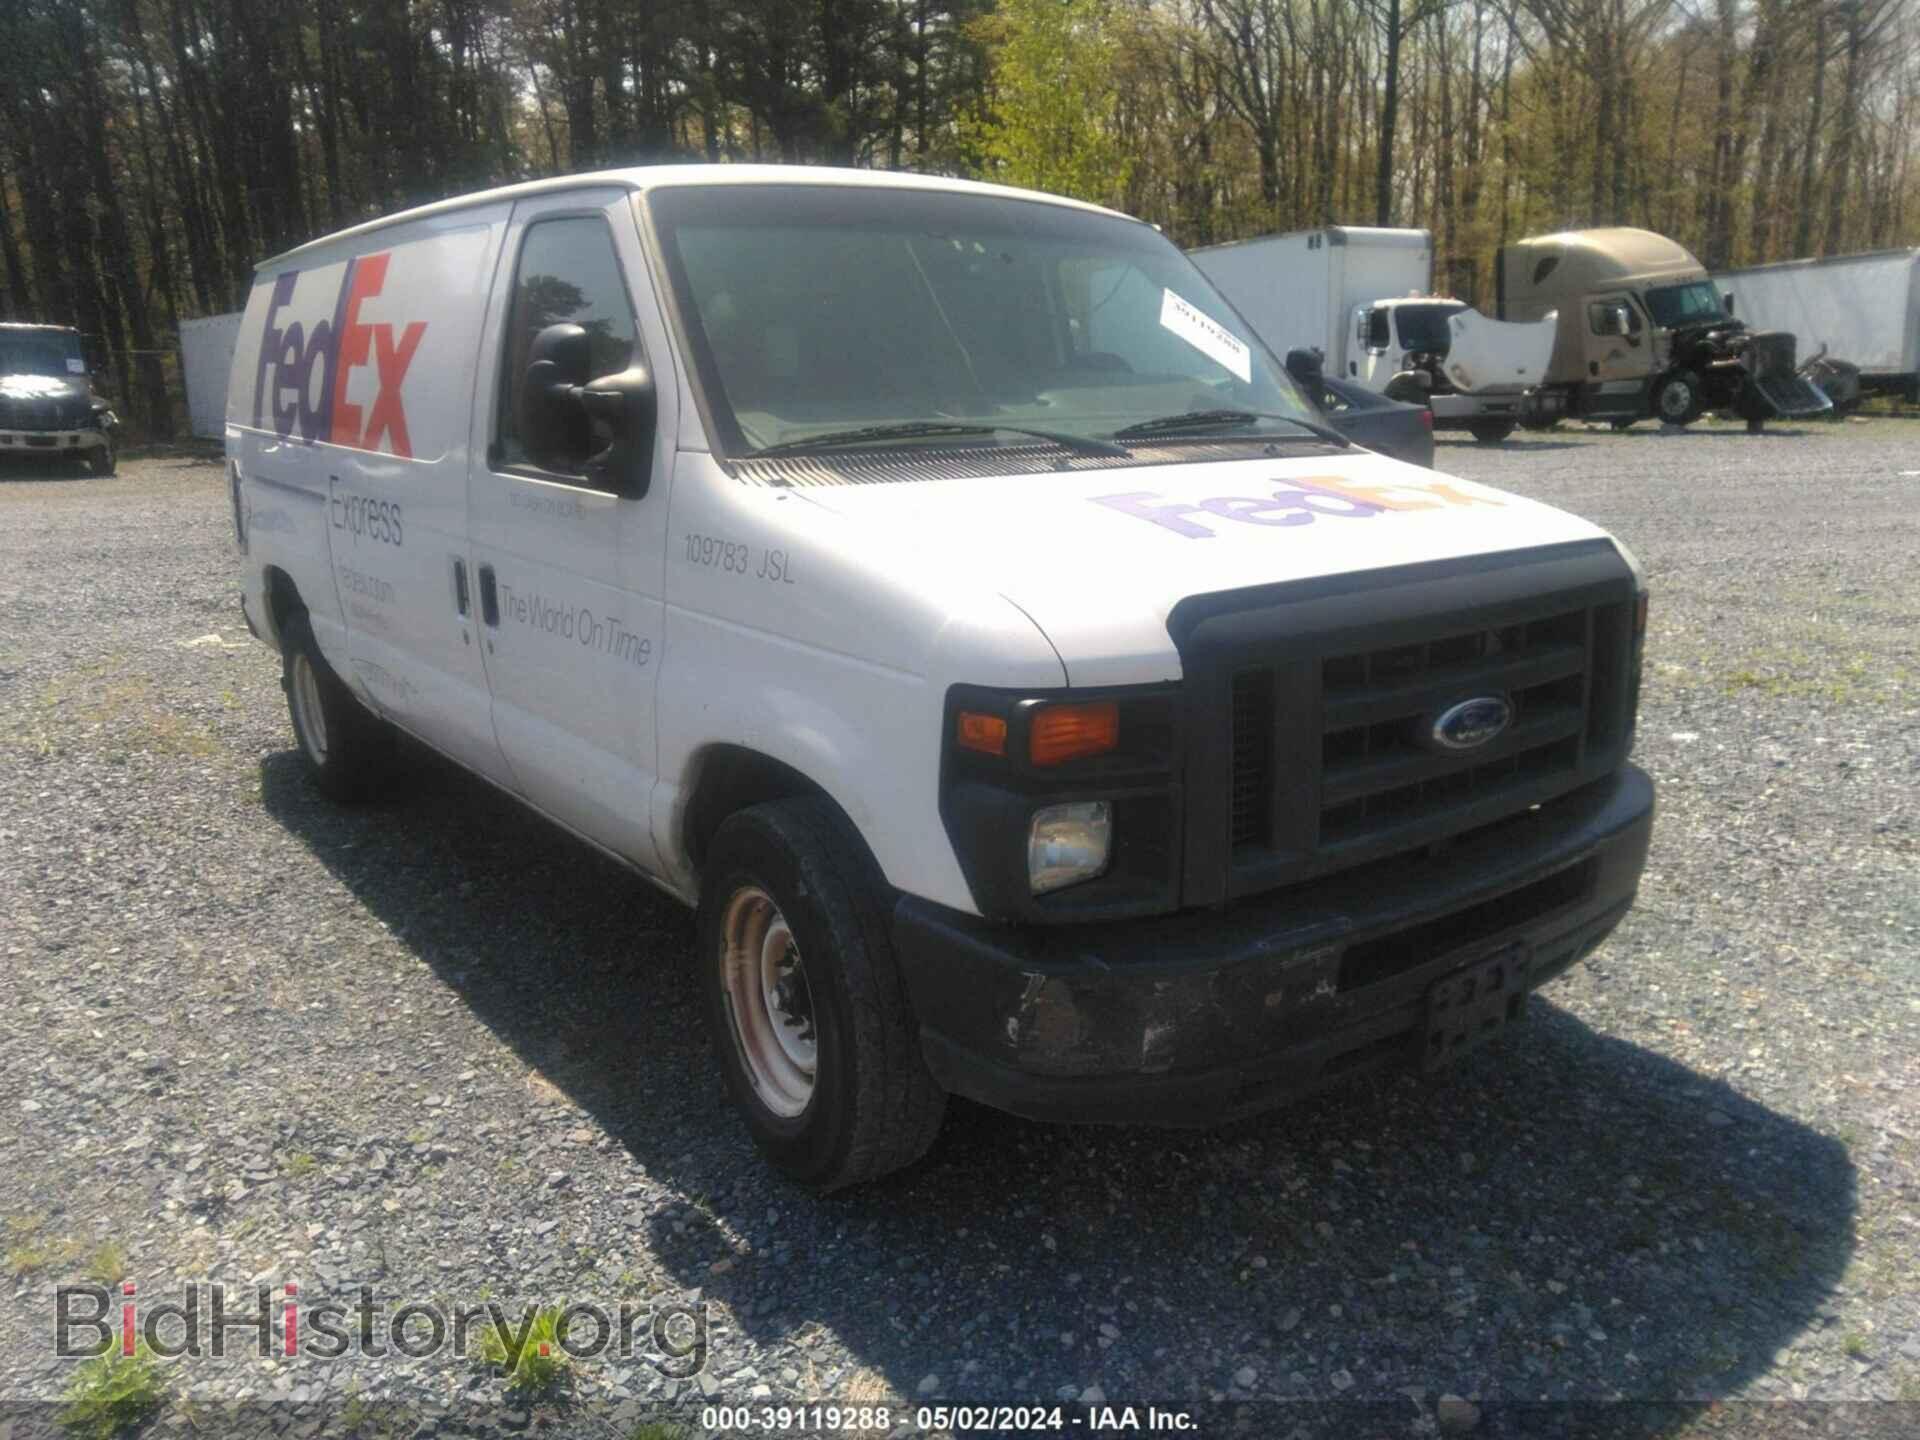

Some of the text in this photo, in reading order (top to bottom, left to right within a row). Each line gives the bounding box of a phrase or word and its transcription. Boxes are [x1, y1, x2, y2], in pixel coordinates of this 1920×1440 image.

[252, 248, 430, 460] FedEx
[329, 474, 403, 547] Express
[1085, 475, 1510, 539] FedEx
[685, 533, 796, 585] 109783 JSL
[500, 584, 652, 667] The World On Time
